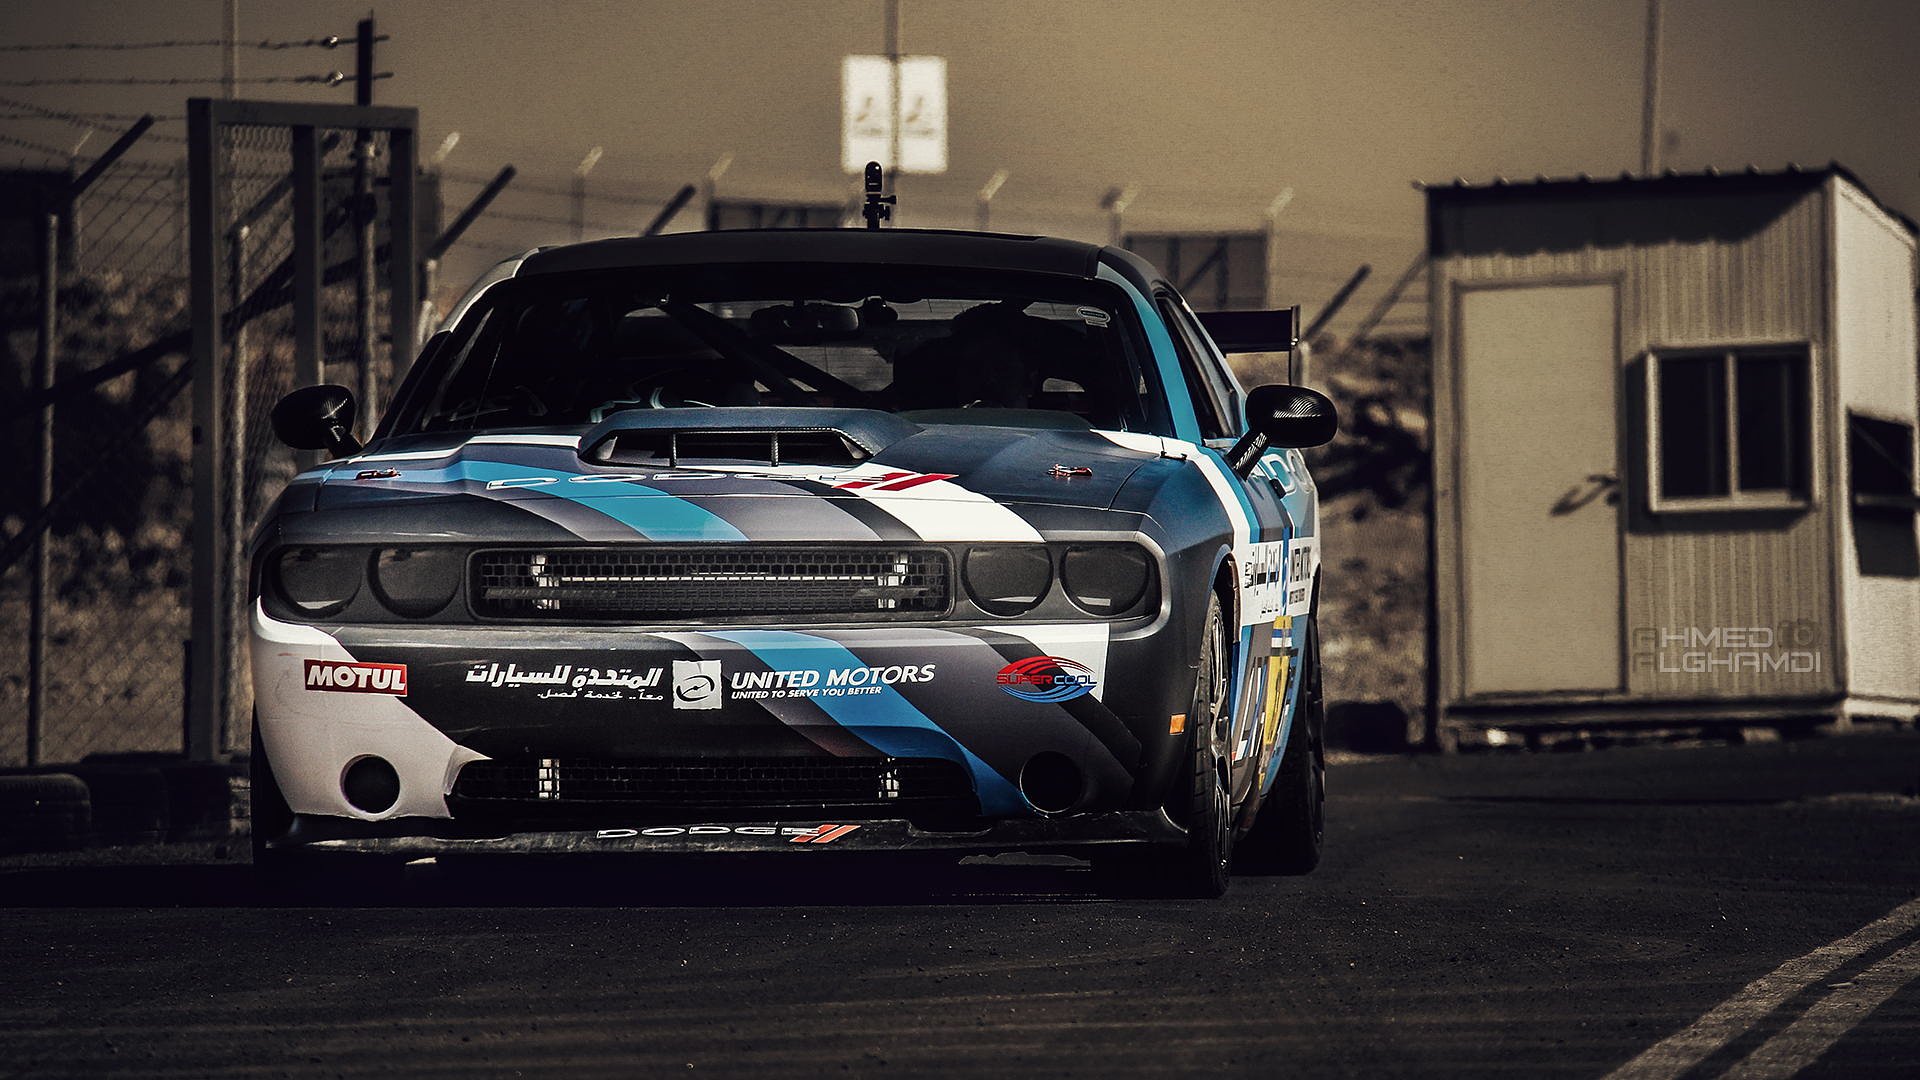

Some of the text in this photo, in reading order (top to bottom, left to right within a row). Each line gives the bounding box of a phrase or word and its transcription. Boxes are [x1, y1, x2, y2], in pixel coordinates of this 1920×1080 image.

[486, 472, 887, 490] DODGE
[306, 665, 406, 690] MOTUL
[464, 663, 664, 689] المتحدة للسيارات
[731, 664, 936, 690] UNITED MOTORS
[996, 674, 1098, 685] SUPERCOOL
[731, 686, 882, 700] UNITED TO SERVE YOU BETTER
[597, 826, 820, 839] DODGE
